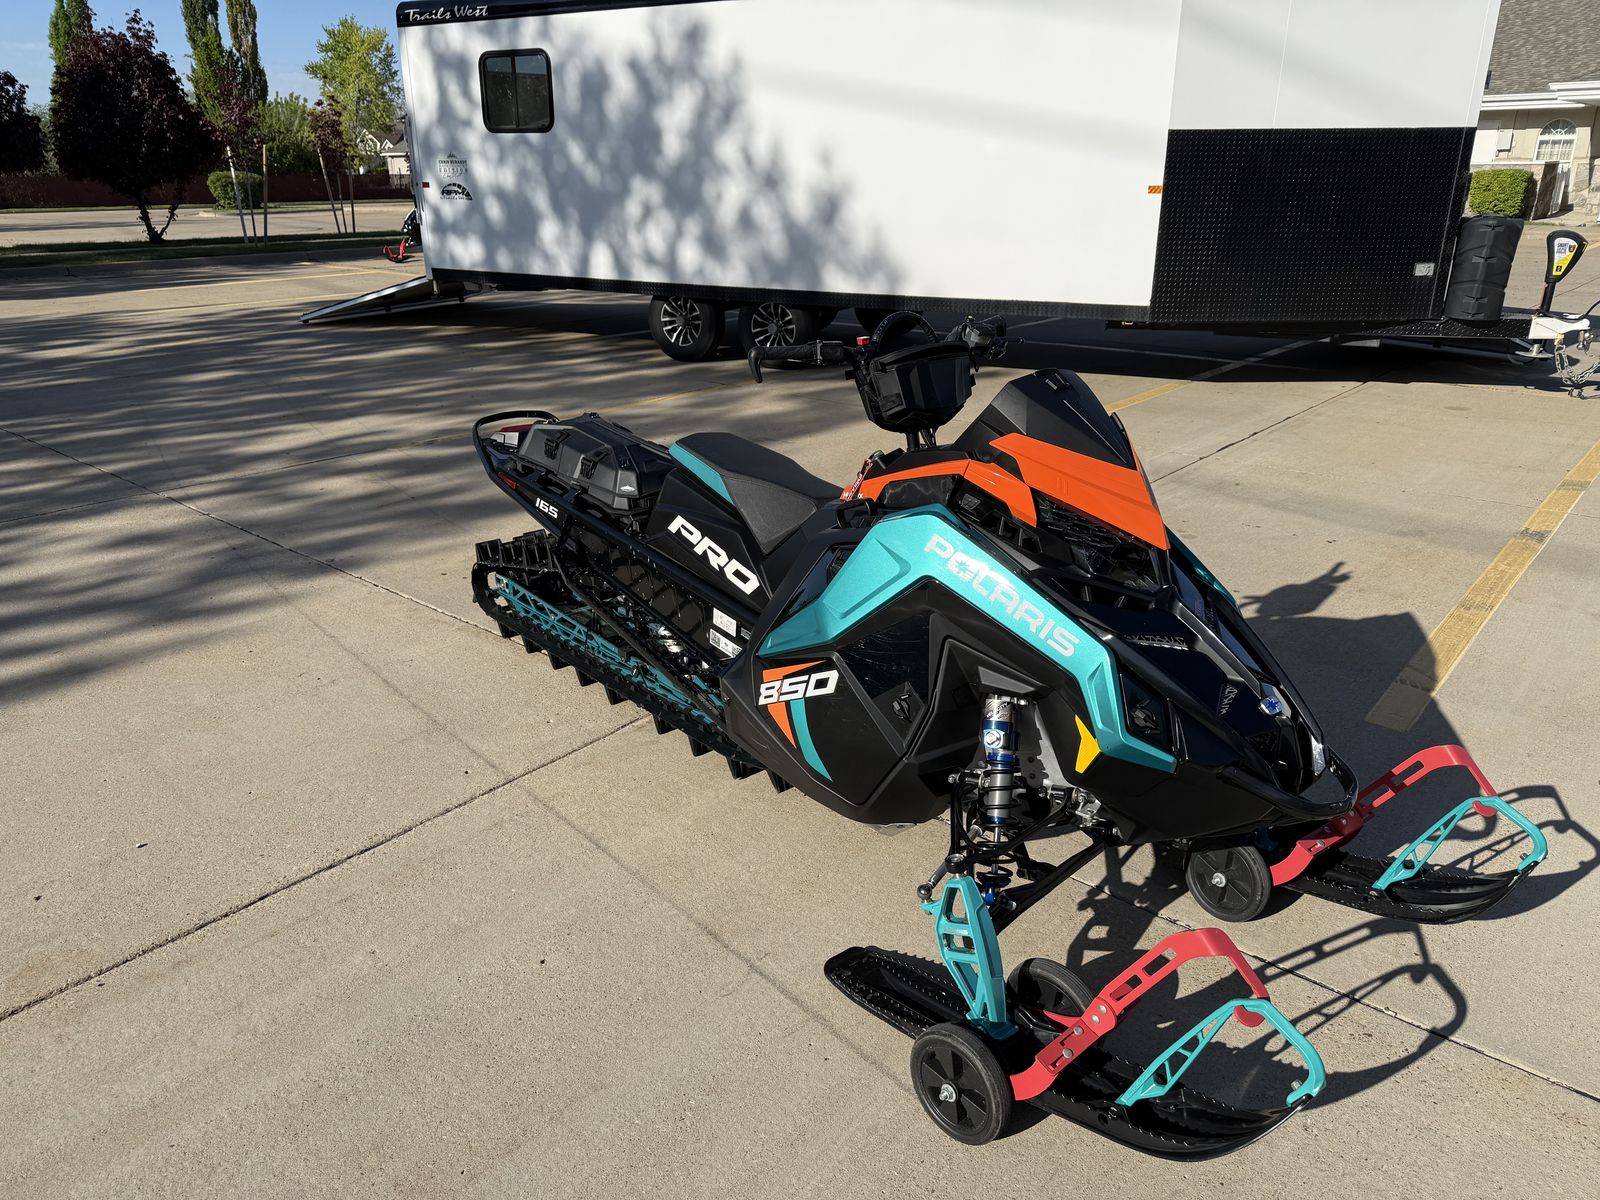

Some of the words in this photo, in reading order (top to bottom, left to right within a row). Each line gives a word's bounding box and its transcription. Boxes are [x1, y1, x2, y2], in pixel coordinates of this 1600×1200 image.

[404, 7, 452, 21] Trails
[454, 5, 488, 18] West
[535, 497, 559, 519] 165
[667, 514, 760, 596] PRO
[924, 533, 1080, 657] POLARIS
[758, 669, 839, 706] 850
